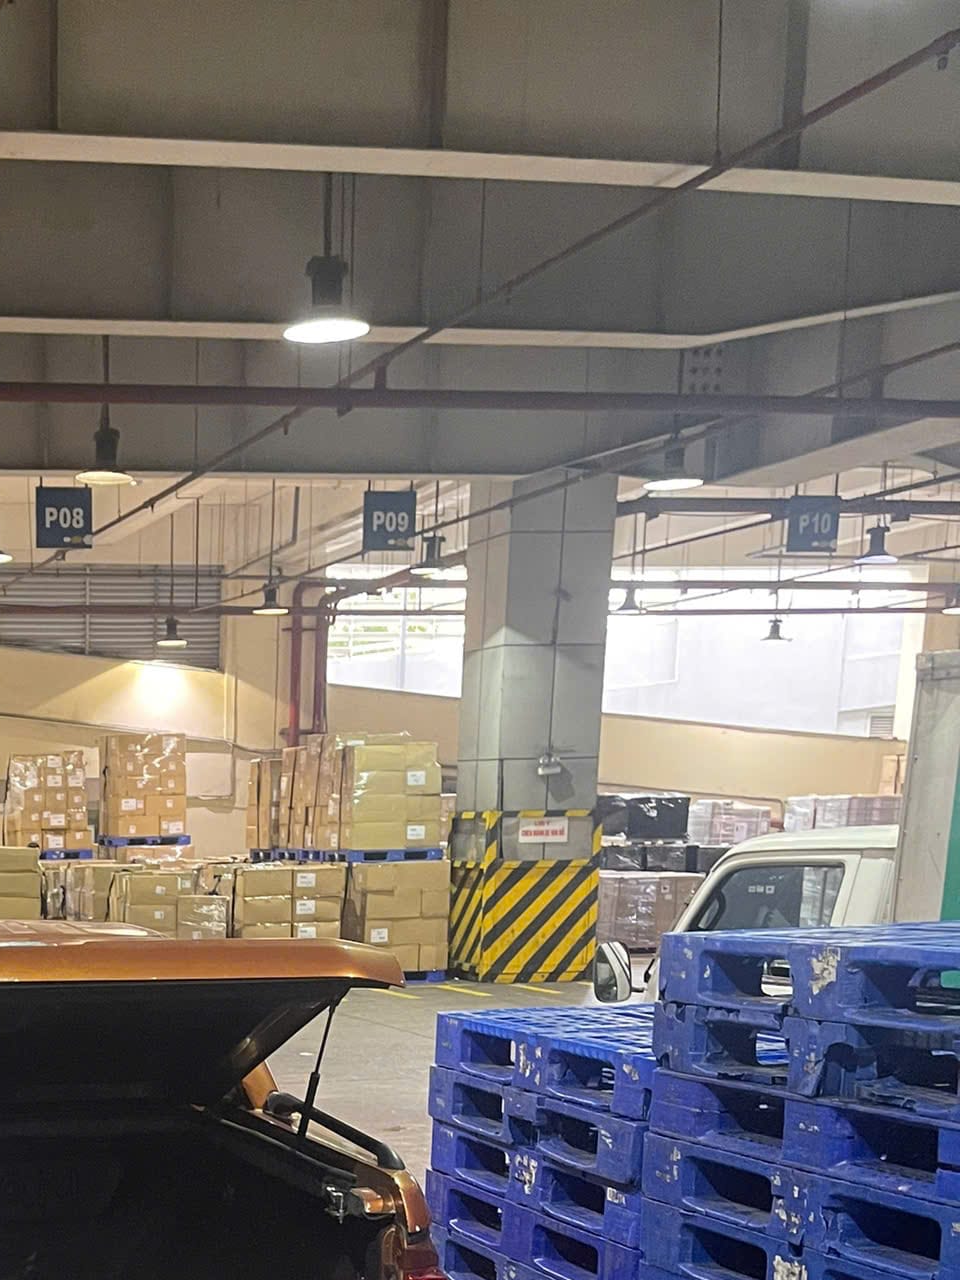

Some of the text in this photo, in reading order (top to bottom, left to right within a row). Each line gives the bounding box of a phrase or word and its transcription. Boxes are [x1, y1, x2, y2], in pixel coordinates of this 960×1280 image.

[45, 507, 84, 528] P08
[372, 511, 409, 532] P09
[799, 511, 831, 535] P10
